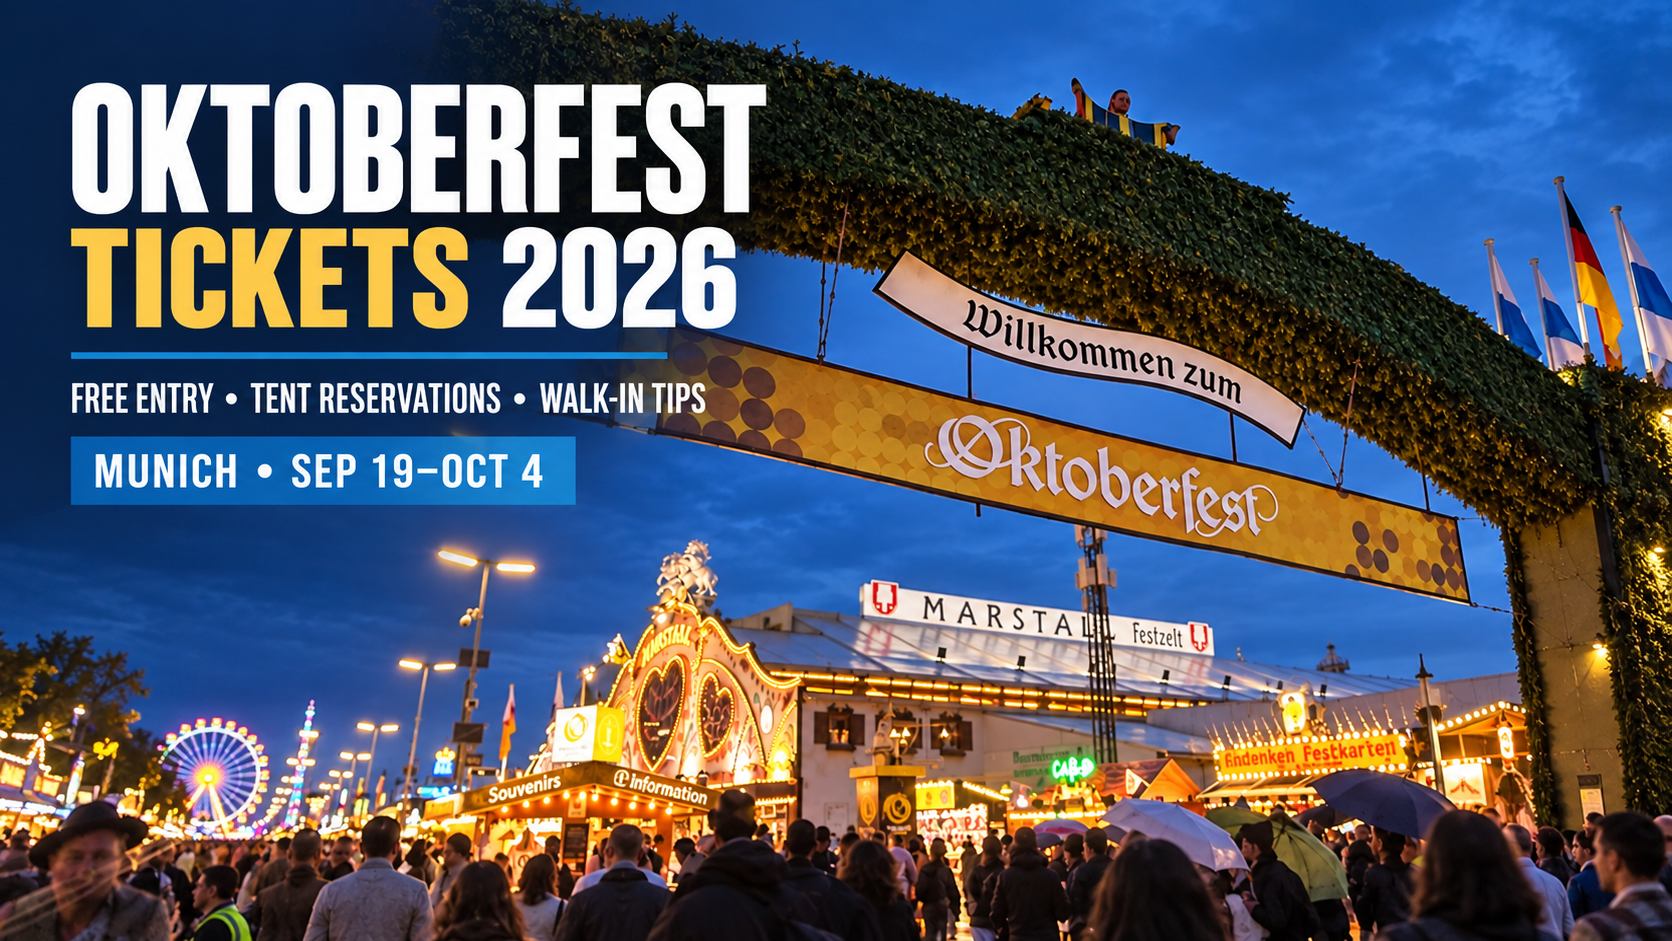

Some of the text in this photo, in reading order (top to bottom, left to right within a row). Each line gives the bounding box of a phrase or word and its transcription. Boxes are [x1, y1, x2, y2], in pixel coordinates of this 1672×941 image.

[962, 299, 1242, 404] Willkommen zum
[924, 414, 1279, 537] Oktoberfest
[1133, 622, 1183, 648] Festzelt
[1303, 740, 1397, 762] Festkarten
[488, 774, 562, 804] Souvenirs
[629, 773, 708, 805] information
